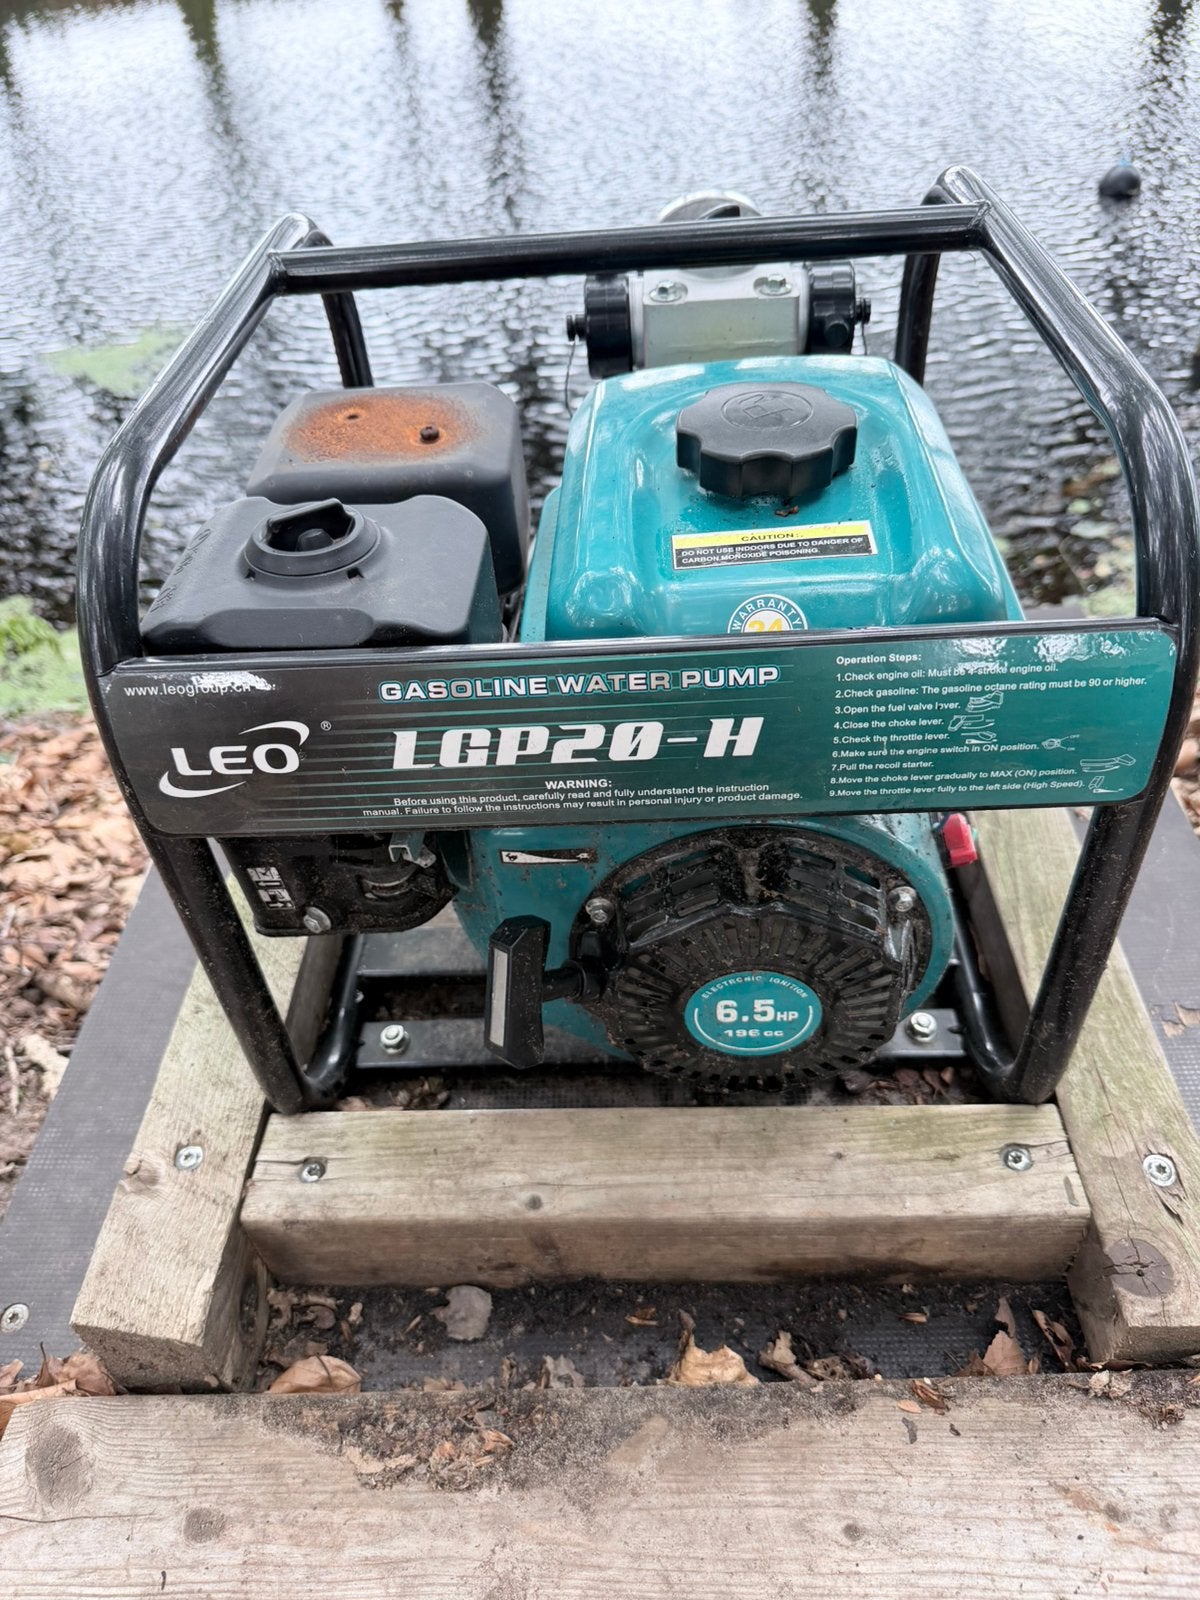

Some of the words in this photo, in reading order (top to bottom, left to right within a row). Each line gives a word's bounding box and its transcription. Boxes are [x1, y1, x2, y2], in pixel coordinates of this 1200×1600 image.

[735, 544, 776, 552] INDOORS
[682, 555, 719, 564] CARBON
[720, 551, 768, 560] MONOXIDE
[732, 598, 802, 630] WARRANTY
[836, 654, 886, 665] Operation
[888, 653, 921, 662] Steps:
[836, 672, 874, 681] 1.Check
[876, 670, 909, 681] engine
[910, 669, 925, 678] oil:
[928, 669, 951, 678] Must
[953, 667, 965, 676] be
[1010, 665, 1042, 674] engine
[1044, 664, 1058, 672] oil.
[380, 677, 549, 701] GASOLINE
[557, 671, 670, 695] WATER
[681, 666, 779, 689] PUMP
[834, 688, 874, 698] 2.Check
[875, 687, 918, 698] gasoline:
[920, 685, 940, 694] The
[941, 684, 982, 695] gasoline
[984, 683, 1017, 692] octane
[1018, 680, 1047, 690] rating
[1048, 680, 1072, 688] must
[1074, 679, 1087, 688] be
[1088, 677, 1101, 687] 90
[1114, 676, 1147, 687] higher.
[834, 705, 868, 714] 3.Open
[870, 704, 886, 712] the
[887, 703, 906, 712] fuel
[907, 702, 933, 710] valve
[934, 701, 960, 710] lever.
[833, 720, 869, 729] 4.Close
[888, 718, 917, 727] choke
[392, 716, 764, 770] LGP20-H
[832, 735, 871, 744] 5.Check
[872, 734, 888, 743] the
[890, 734, 922, 742] throttle
[906, 747, 938, 756] engine
[940, 745, 969, 753] switch
[1000, 743, 1039, 752] position.
[170, 742, 300, 776] LEO
[934, 771, 978, 781] gradually
[1014, 769, 1038, 777] (ON)
[1038, 768, 1077, 776] position.
[545, 778, 613, 790] WARNING:
[937, 785, 957, 793] fully
[1022, 781, 1049, 790] (High
[1049, 780, 1085, 788] Speed).
[394, 798, 427, 806] Before
[430, 796, 456, 805] using
[522, 792, 565, 801] carefully
[593, 789, 611, 798] and
[614, 788, 635, 798] fully
[637, 786, 694, 796] understand
[716, 784, 769, 792] instruction
[363, 808, 403, 816] manual.
[405, 806, 440, 815] Failure
[454, 804, 482, 812] follow
[485, 803, 501, 811] the
[503, 801, 560, 811] instructions
[563, 801, 584, 809] may
[628, 796, 672, 806] personal
[674, 796, 702, 805] injury
[718, 794, 757, 803] product
[759, 792, 803, 801] damage.
[702, 976, 762, 999] ELECTRONIC
[769, 977, 808, 998] IGNITION
